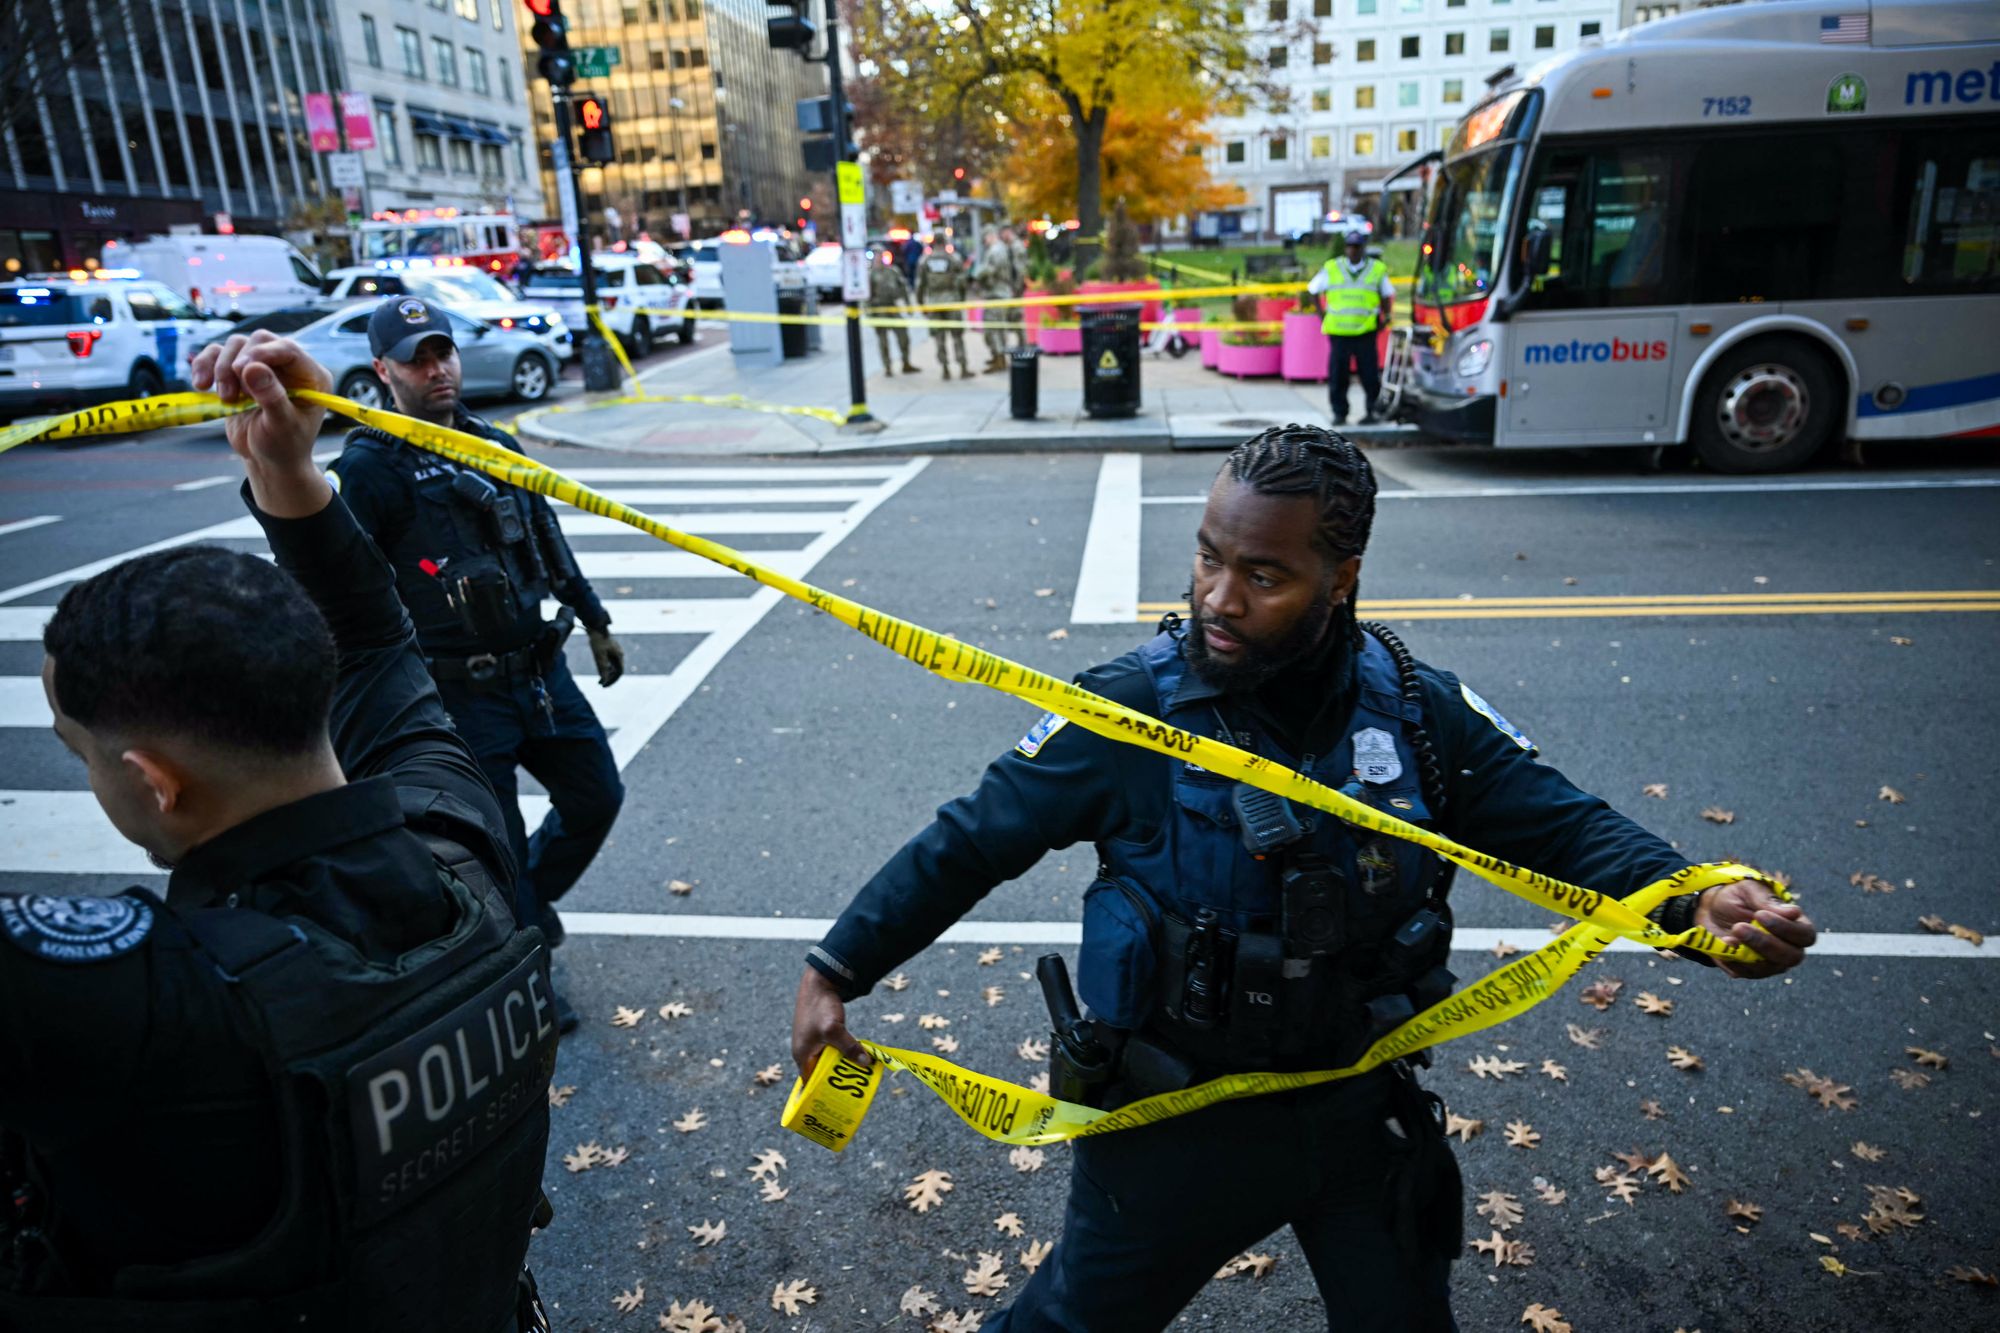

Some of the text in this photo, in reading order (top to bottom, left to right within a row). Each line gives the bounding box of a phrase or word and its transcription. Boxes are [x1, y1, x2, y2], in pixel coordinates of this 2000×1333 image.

[1702, 96, 1752, 118] 7152
[1524, 335, 1669, 365] metrobus
[367, 967, 553, 1156] POLICE
[380, 1115, 478, 1203] SECRET
